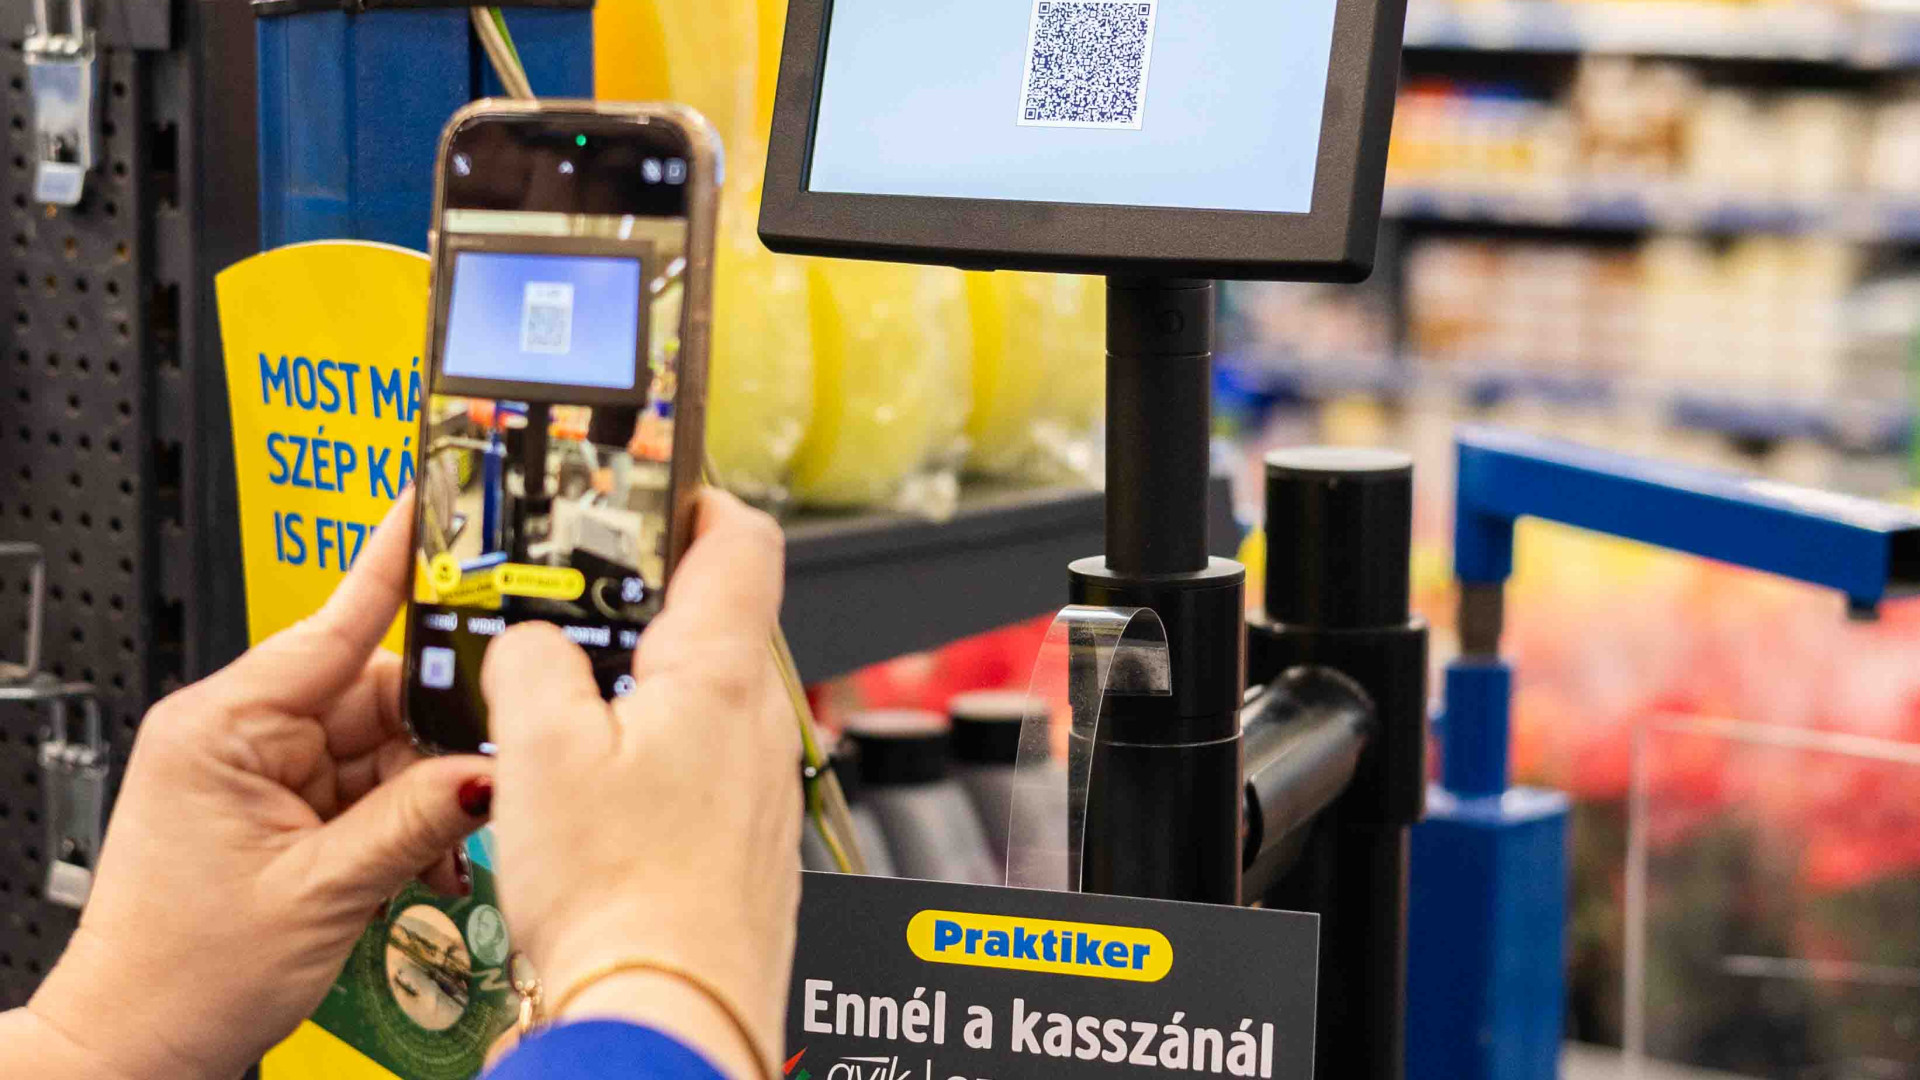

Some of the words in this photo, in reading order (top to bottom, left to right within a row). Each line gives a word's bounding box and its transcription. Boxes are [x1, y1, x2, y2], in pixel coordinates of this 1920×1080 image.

[258, 352, 360, 416] MOST
[266, 425, 358, 493] SZÉP
[273, 510, 307, 565] IS
[315, 516, 378, 572] FIZ
[933, 919, 1151, 971] Praktiker
[803, 978, 946, 1045] Ennél
[962, 1004, 993, 1050] a
[1011, 998, 1275, 1079] kasszánál
